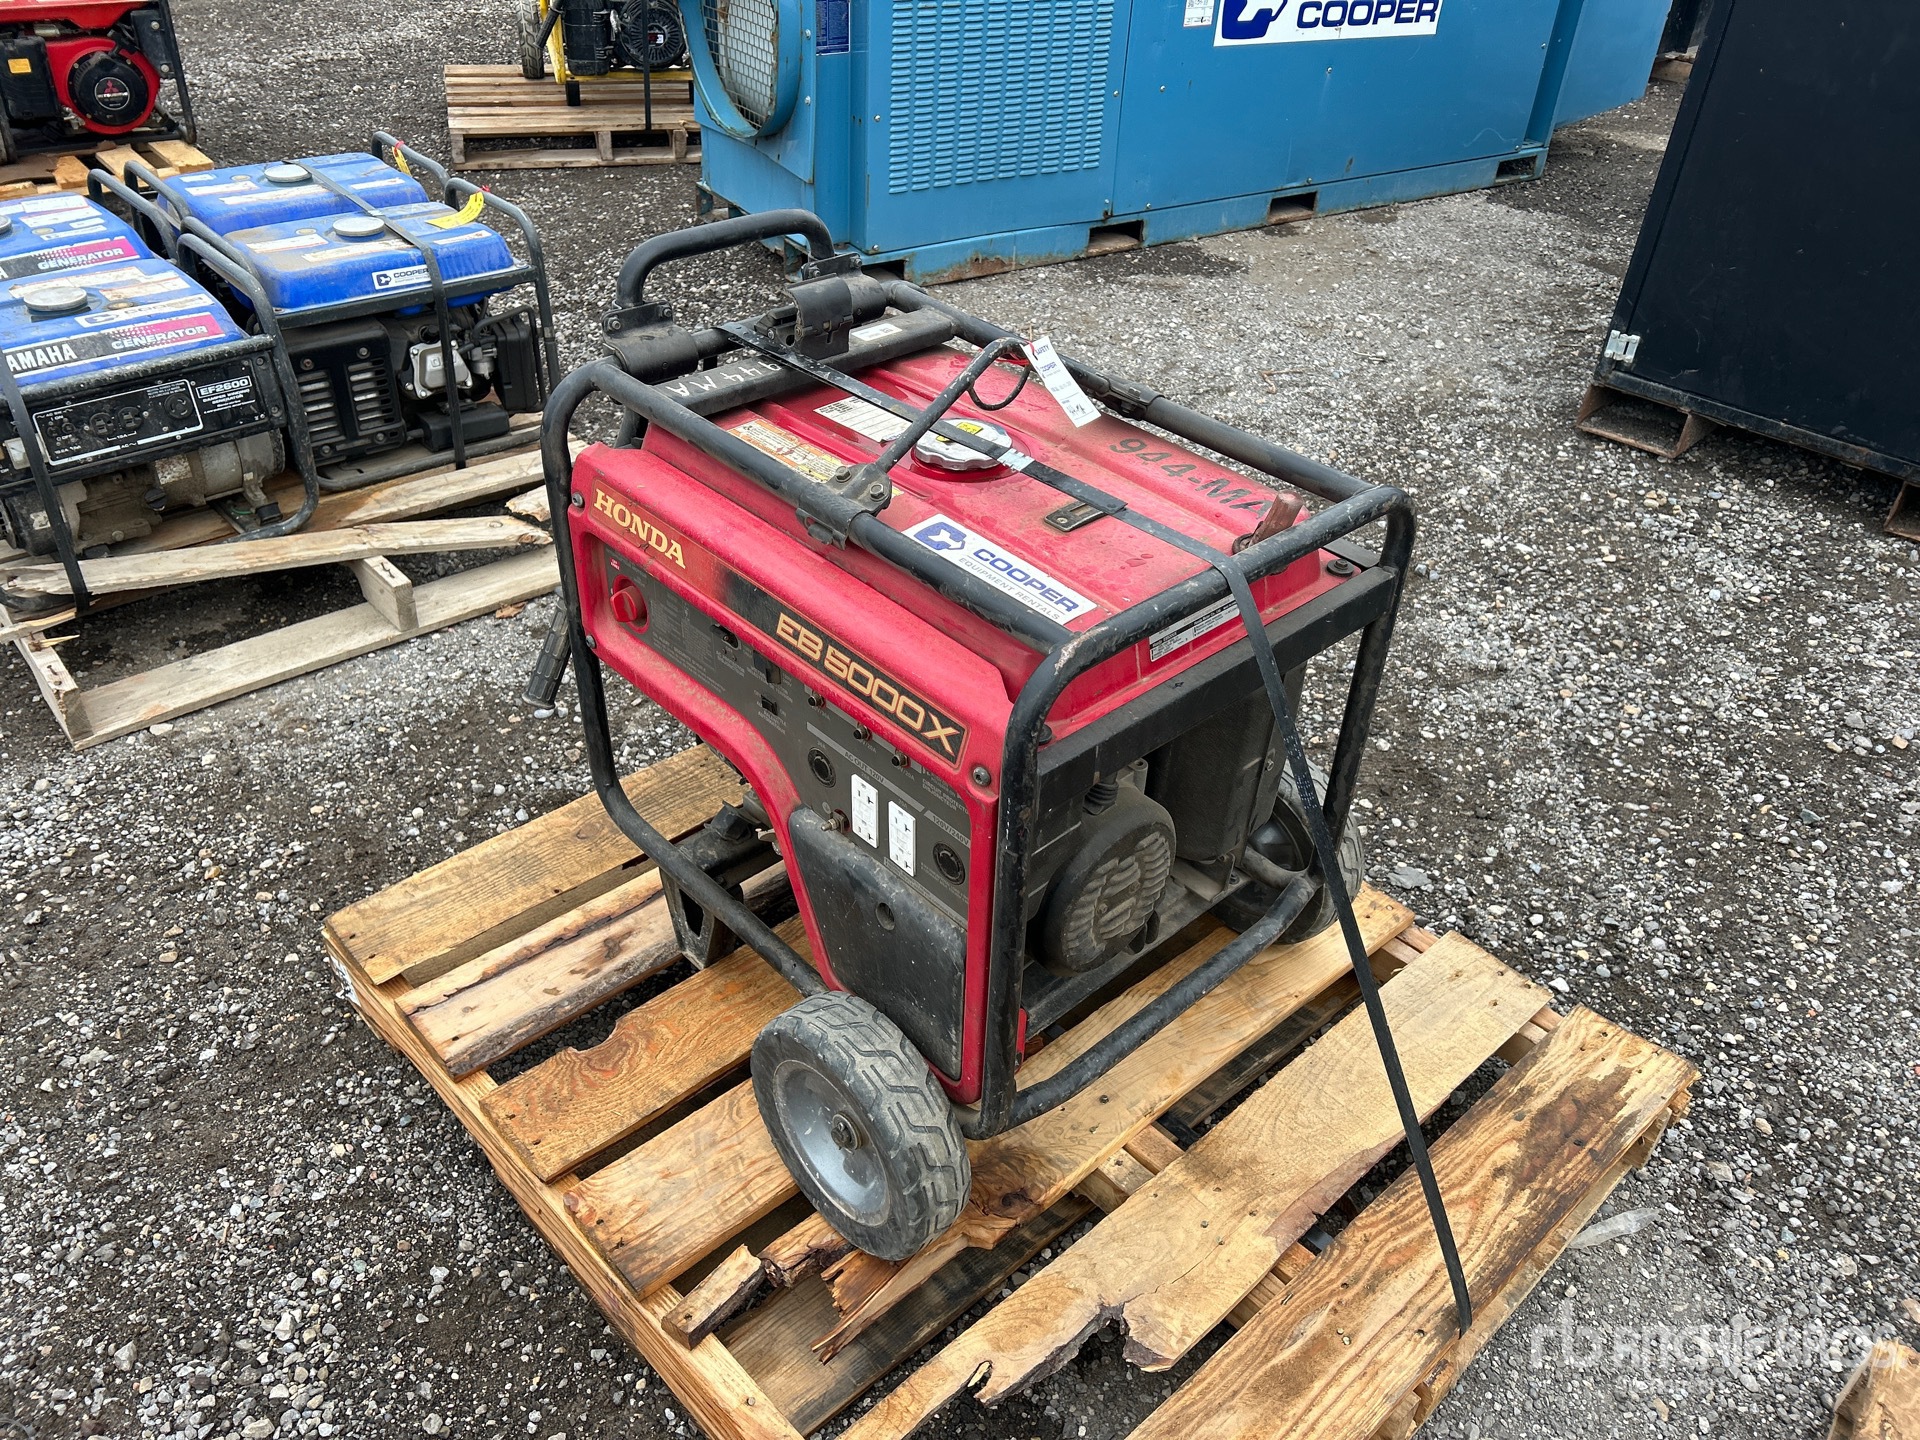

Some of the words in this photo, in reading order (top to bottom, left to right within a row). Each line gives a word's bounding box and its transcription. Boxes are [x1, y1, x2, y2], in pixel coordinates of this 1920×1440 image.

[1297, 0, 1439, 29] COOPER
[37, 247, 125, 270] GENERATOR
[393, 267, 430, 278] COOPER
[111, 325, 208, 350] GENERATOR
[5, 343, 78, 372] AMAHA
[200, 378, 249, 396] EF2600
[1109, 437, 1275, 520] 944-MA
[593, 488, 687, 570] HONDA
[958, 557, 1016, 592] EQUIPMENT
[1014, 590, 1061, 621] RENTALS
[972, 548, 1080, 613] COOPER
[869, 769, 885, 784] 120V
[942, 792, 969, 815] PROTECTO
[932, 815, 970, 846] 120V/240V
